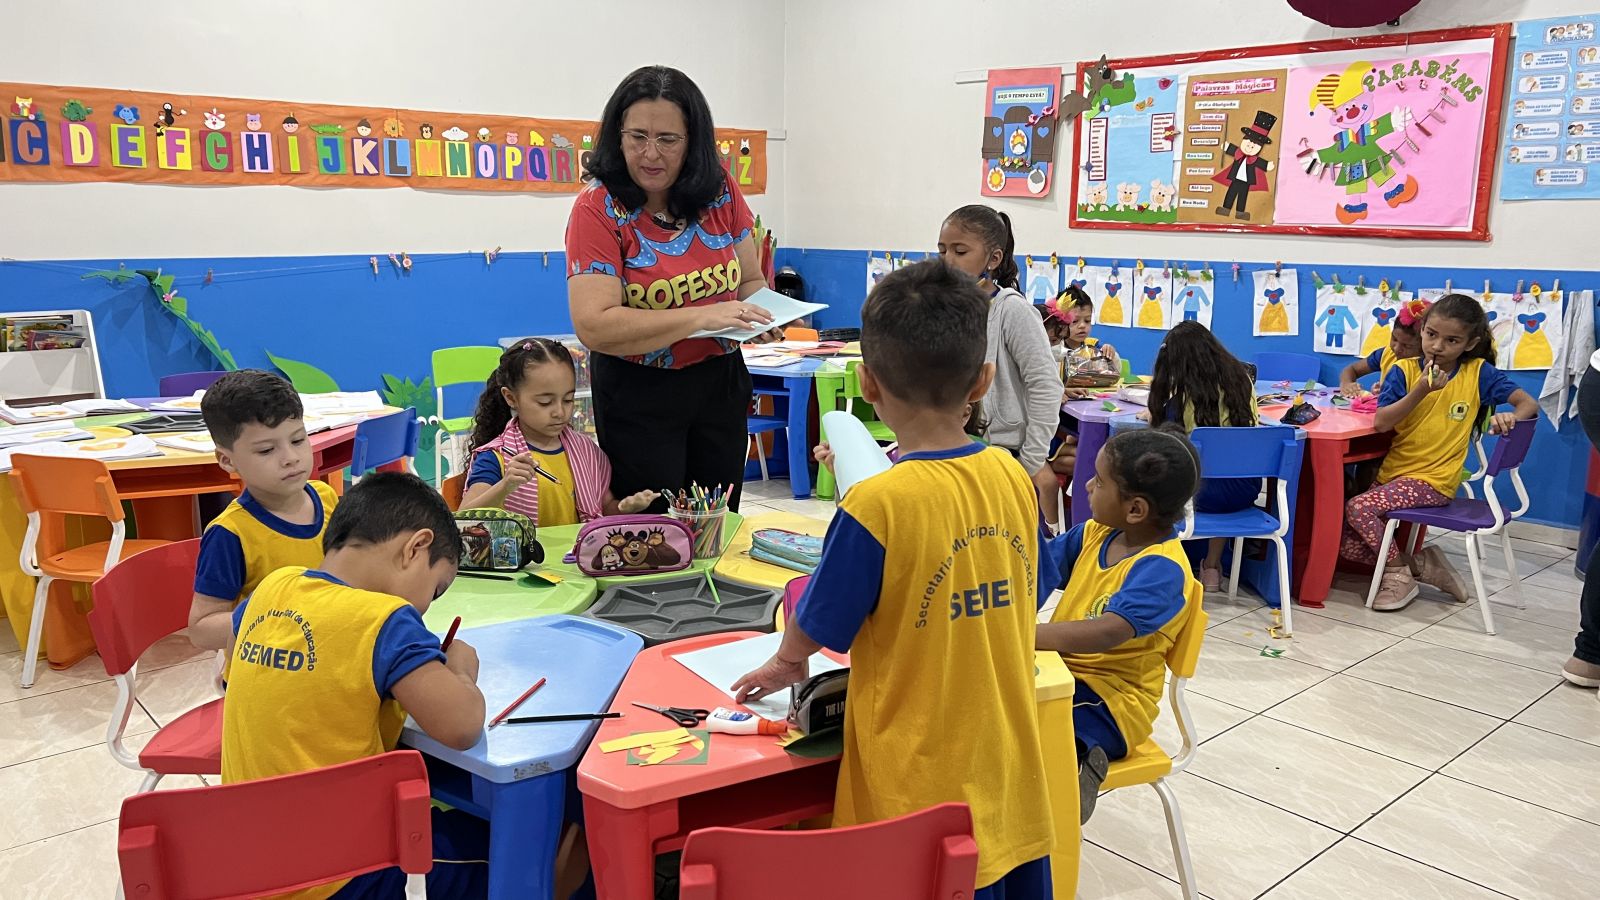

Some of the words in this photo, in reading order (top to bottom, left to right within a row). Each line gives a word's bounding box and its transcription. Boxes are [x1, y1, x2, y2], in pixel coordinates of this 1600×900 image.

[1363, 58, 1483, 102] PARABÉNS
[18, 122, 42, 162] C
[69, 123, 94, 164] D
[119, 127, 143, 166] E
[165, 129, 188, 167] F
[206, 134, 228, 170] G
[246, 134, 268, 171] H
[289, 136, 300, 172] I
[323, 138, 339, 172] J
[353, 138, 379, 174] K
[388, 142, 407, 174] L
[418, 143, 442, 175] M
[449, 143, 470, 175] N
[478, 144, 493, 178] O
[506, 146, 522, 179] P
[529, 146, 548, 181] Q
[556, 149, 573, 182] R
[738, 157, 752, 185] Z
[623, 257, 742, 310] ROFESSO
[915, 556, 953, 629] Secretaria
[952, 524, 999, 555] Muicipal
[1011, 535, 1034, 597] Educação
[240, 642, 305, 672] SEMED
[301, 621, 317, 671] Educação
